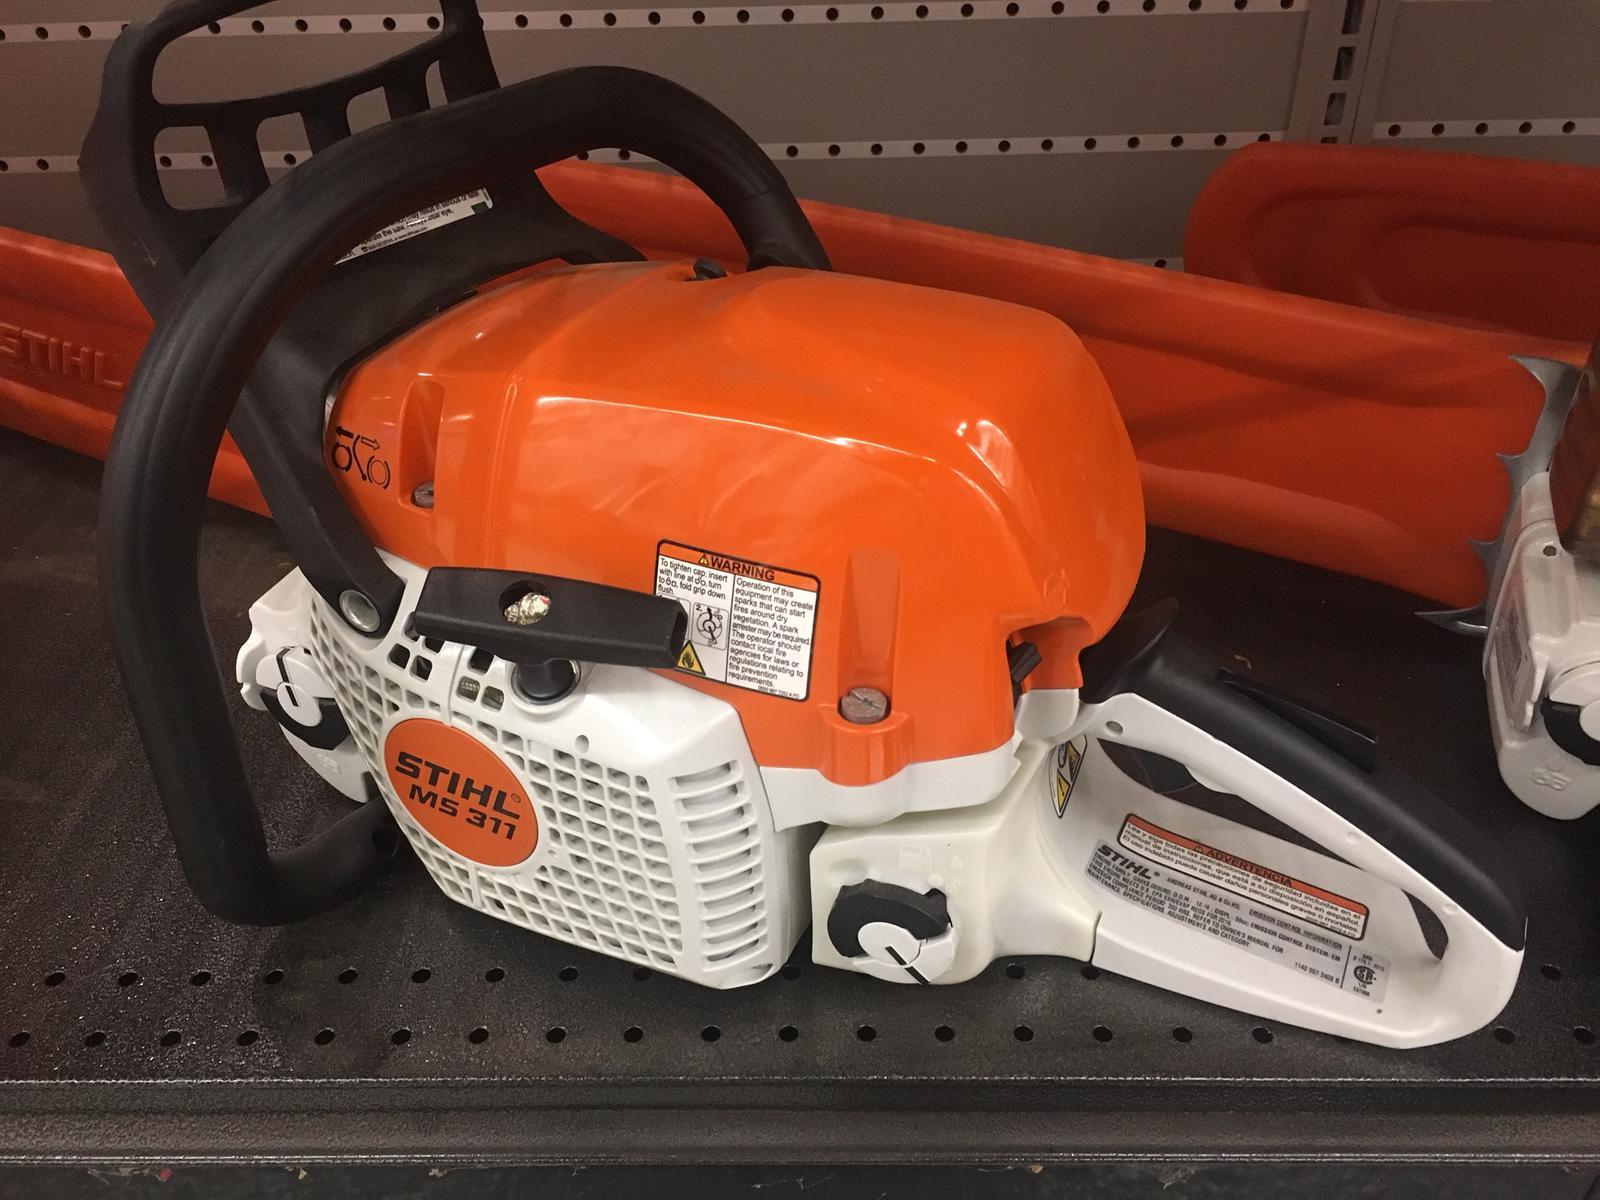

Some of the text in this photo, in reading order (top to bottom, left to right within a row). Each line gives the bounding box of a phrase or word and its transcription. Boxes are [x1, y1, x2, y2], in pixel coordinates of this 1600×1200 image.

[658, 576, 665, 584] to
[659, 568, 694, 583] with line at
[660, 558, 668, 567] To
[670, 561, 692, 573] tighten
[708, 572, 728, 582] insert
[710, 556, 775, 581] WARNING
[680, 581, 726, 600] fold grip down
[708, 580, 722, 590] turn
[736, 578, 794, 598] Operation of this
[734, 596, 806, 618] sparks that can start
[736, 588, 814, 610] equipment may create
[733, 614, 799, 634] vegetation. A spark
[734, 604, 788, 624] fires around dry
[732, 622, 757, 633] arrester
[758, 628, 772, 638] may
[732, 628, 801, 652] The operator should
[730, 647, 760, 660] agencies
[762, 653, 772, 662] for
[774, 656, 790, 666] laws
[731, 639, 786, 657] contact local fire
[729, 662, 778, 680] fire prevention
[730, 655, 803, 678] regulations relating to
[728, 671, 774, 688] requirements.
[396, 751, 520, 820] STIHL
[409, 784, 518, 840] MS 311
[1098, 844, 1152, 880] STIHL
[1125, 830, 1151, 846] manual
[1152, 843, 1162, 852] de
[1216, 867, 1230, 877] que
[1269, 886, 1313, 910] disposición
[1127, 824, 1140, 834] Lea
[1148, 834, 1164, 846] siga
[1165, 841, 1185, 854] todas
[1187, 850, 1198, 858] las
[1200, 856, 1250, 878] precauciones
[1252, 874, 1262, 882] de
[1264, 880, 1303, 898] seguridad
[1341, 909, 1351, 917] en
[1206, 849, 1293, 888] ADVERTENCIA
[1131, 840, 1144, 849] uso
[1144, 846, 1175, 862] indebido
[1175, 859, 1198, 872] puede
[1198, 867, 1223, 881] causar
[1224, 878, 1248, 891] daños
[1248, 887, 1290, 907] personales
[1290, 903, 1316, 917] graves
[1122, 876, 1139, 889] MEETS
[1206, 912, 1218, 920] FOR
[1112, 878, 1144, 898] COMPLIANCE
[1193, 913, 1211, 924] REFER
[1220, 925, 1246, 938] OWNER'S
[1247, 935, 1270, 949] MANUAL
[1272, 944, 1284, 954] FOR
[1167, 910, 1206, 930] ADJUSTMENTS
[1208, 926, 1220, 936] AND
[1249, 909, 1276, 924] EMISSION
[1276, 919, 1301, 934] CONTROL
[1304, 930, 1342, 950] INFORMATION
[1250, 922, 1277, 937] EMISSION
[1278, 933, 1303, 948] CONTROL
